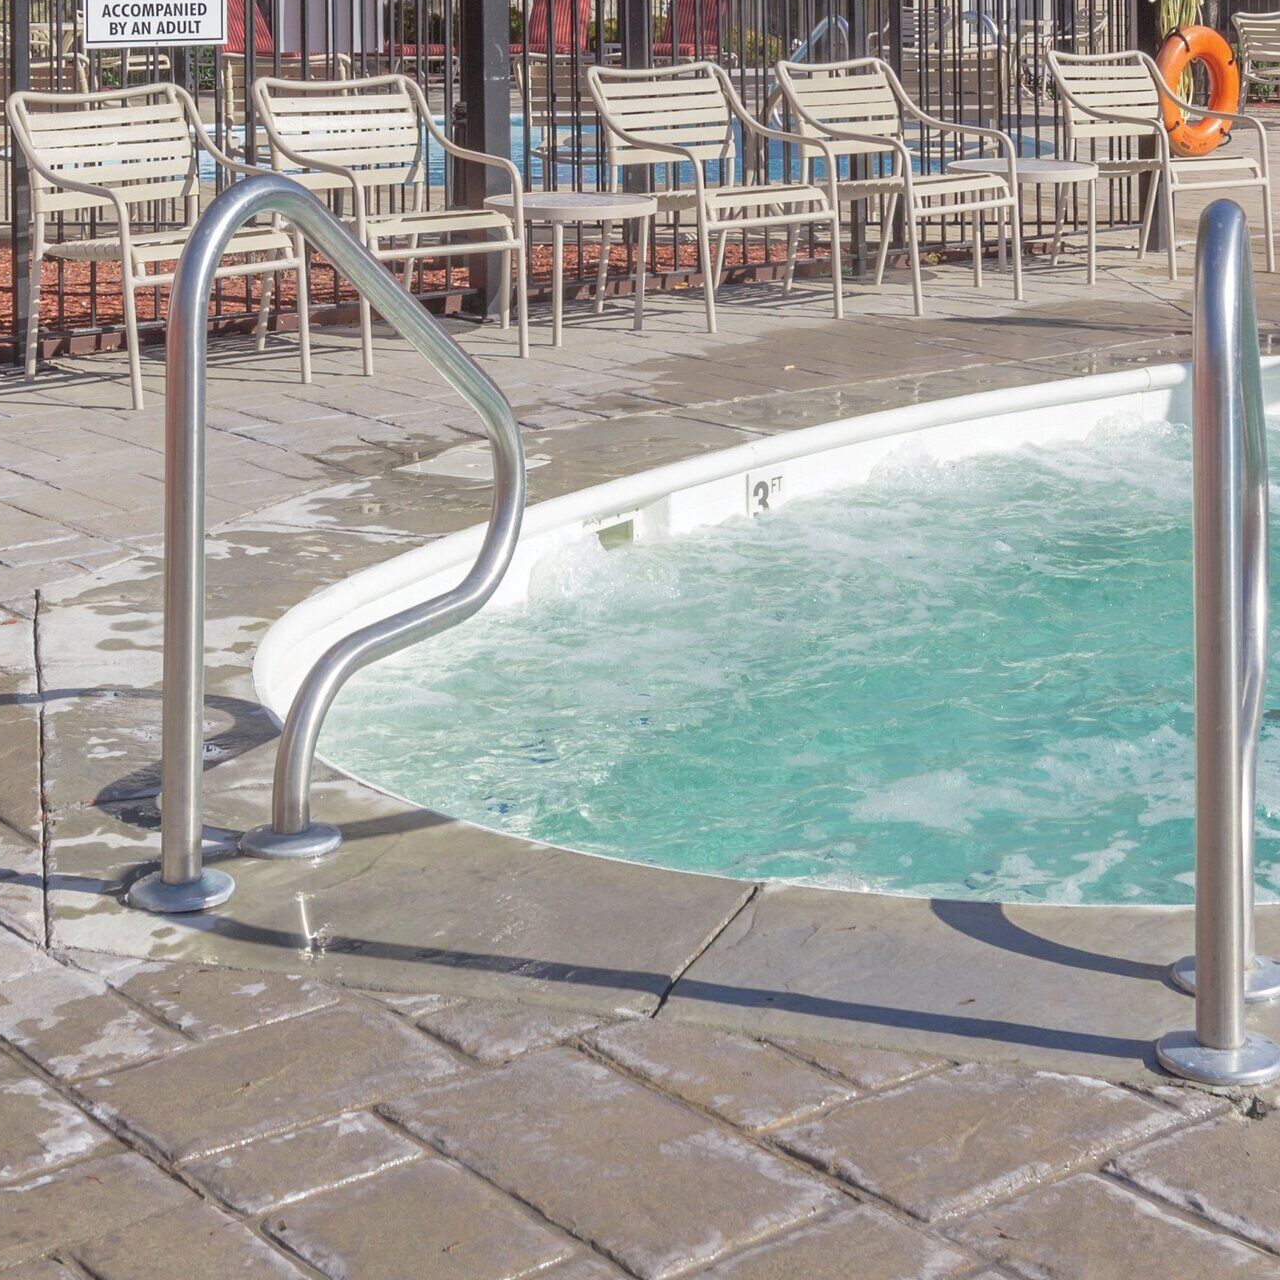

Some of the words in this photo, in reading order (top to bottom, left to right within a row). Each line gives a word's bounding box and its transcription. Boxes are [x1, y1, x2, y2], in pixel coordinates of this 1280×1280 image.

[102, 3, 207, 17] ACCOMPANIED
[109, 22, 128, 35] BY
[131, 21, 151, 35] AN
[156, 21, 201, 34] ADULT
[753, 481, 769, 516] 3
[771, 476, 783, 494] FT
